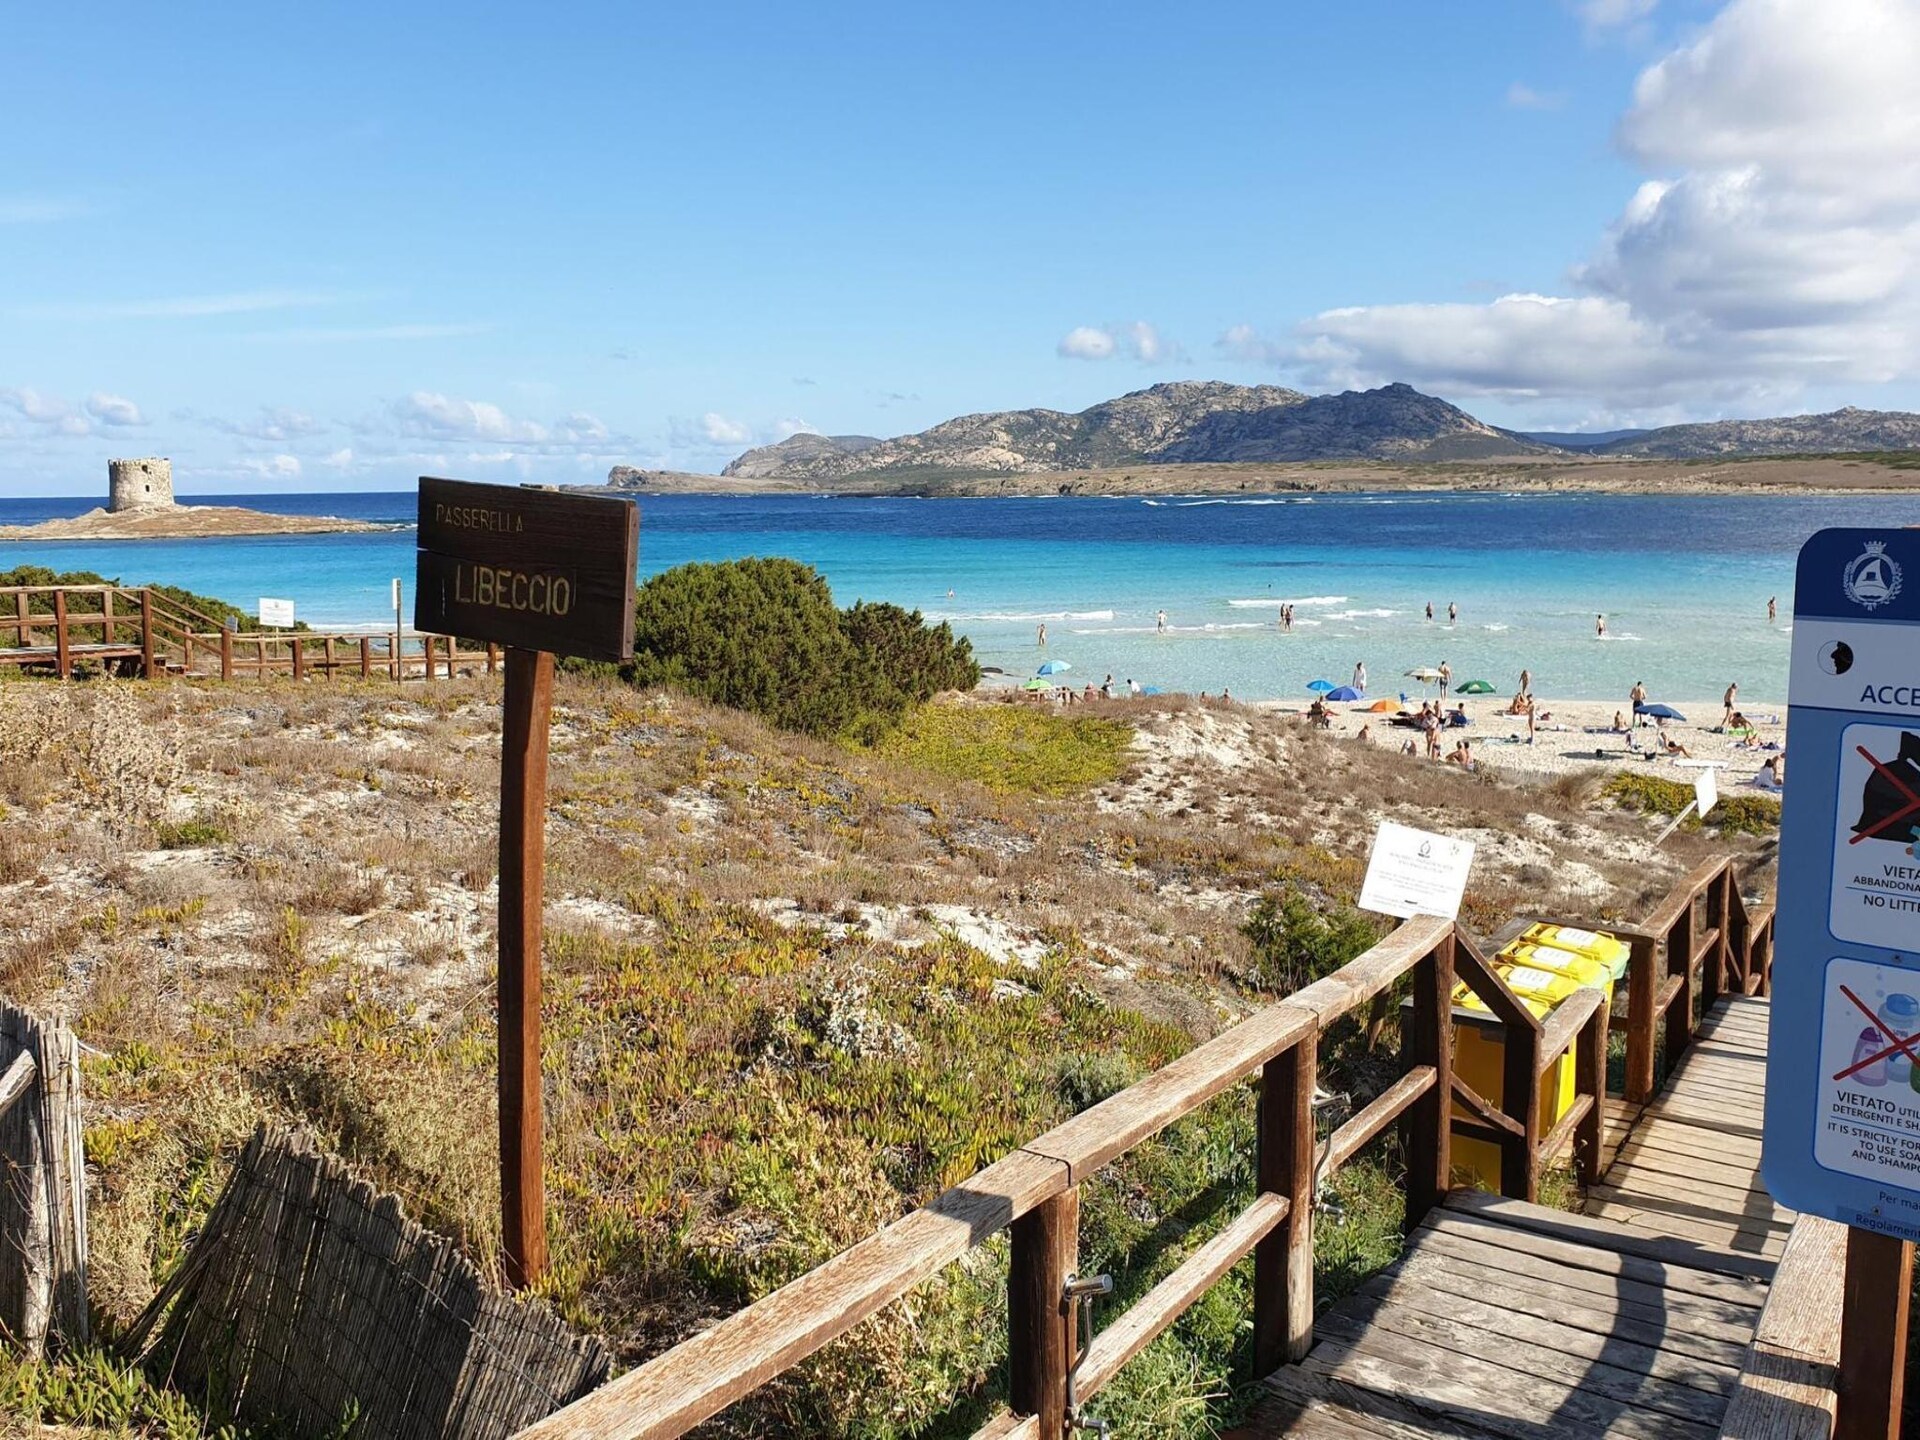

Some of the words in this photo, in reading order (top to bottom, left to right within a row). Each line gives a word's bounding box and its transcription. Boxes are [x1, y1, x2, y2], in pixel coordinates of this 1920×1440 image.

[436, 503, 523, 533] PASSERELLA
[455, 564, 570, 616] LIBECCIO
[1860, 684, 1920, 706] ACCE
[1863, 894, 1885, 908] NO
[1837, 1090, 1896, 1114] VIETATO
[1832, 1103, 1894, 1125] DETERGENTI
[1897, 1118, 1903, 1127] E
[1905, 1120, 1920, 1132] SH
[1828, 1121, 1837, 1131] IT
[1840, 1124, 1849, 1134] IS
[1852, 1127, 1898, 1146] STRICTLY
[1852, 1150, 1876, 1162] AND
[1860, 1139, 1874, 1151] TO
[1877, 1144, 1897, 1157] USE
[1879, 1190, 1898, 1204] Per
[1901, 1199, 1920, 1211] ma
